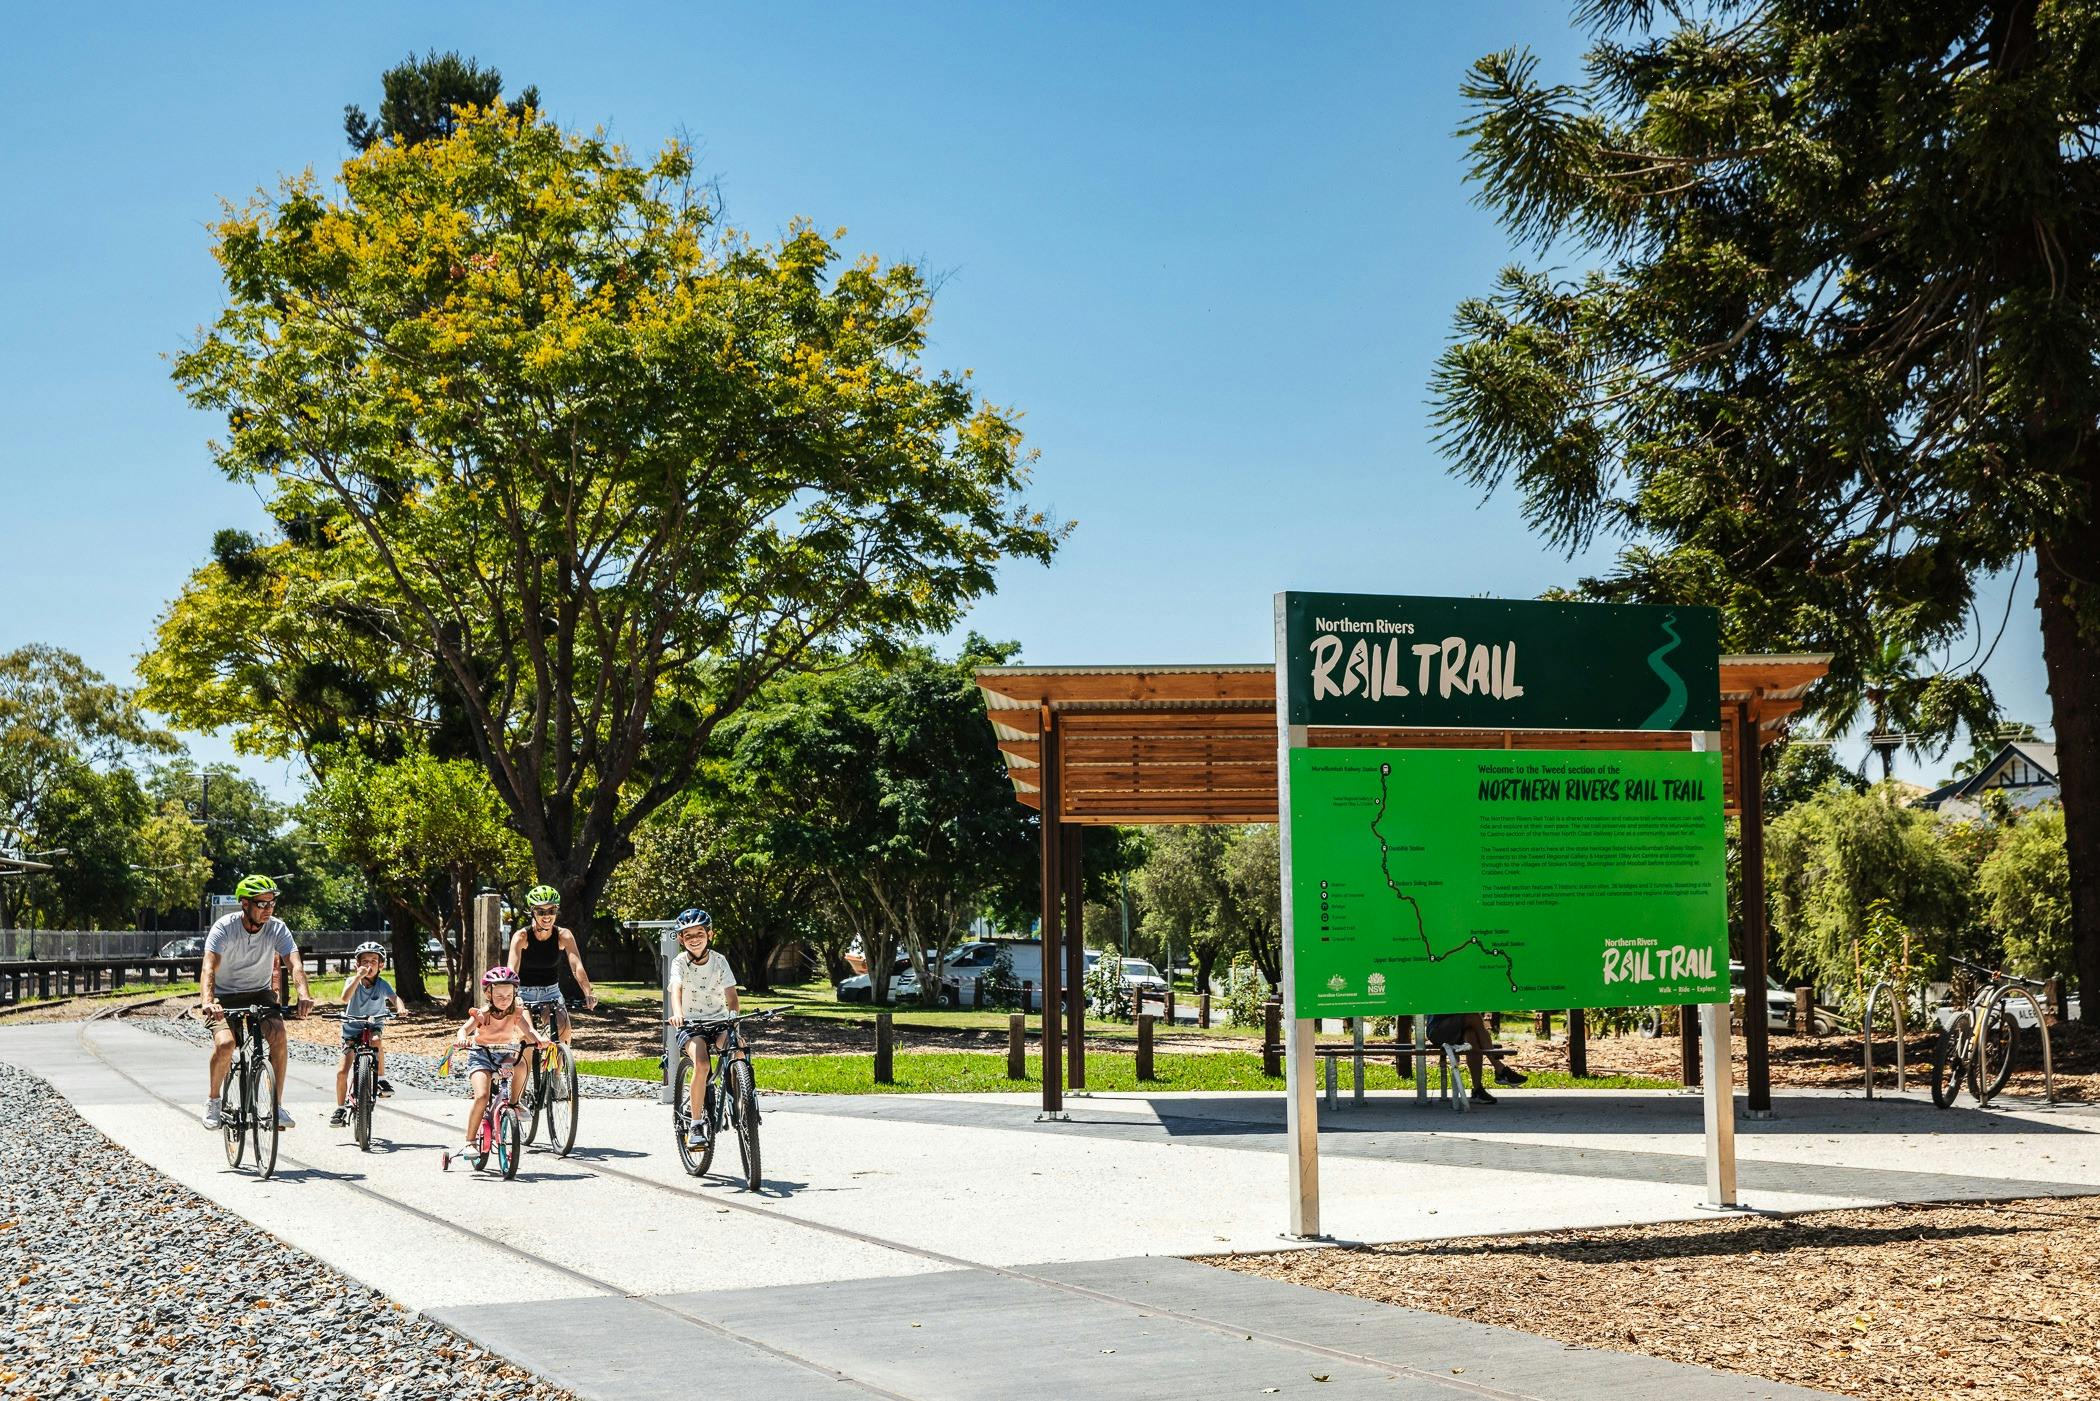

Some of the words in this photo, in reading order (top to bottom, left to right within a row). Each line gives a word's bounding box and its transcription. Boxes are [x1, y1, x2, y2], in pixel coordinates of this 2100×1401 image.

[1316, 617, 1374, 633] Northern
[1376, 619, 1415, 634] Rivers
[1309, 634, 1410, 701] RAIL
[1411, 636, 1524, 701] TRAIL
[1478, 764, 1514, 774] Welcome
[1516, 765, 1524, 774] to
[1526, 764, 1539, 774] the
[1541, 764, 1566, 774] Tweed
[1568, 764, 1596, 774] section
[1598, 764, 1606, 774] of
[1607, 764, 1620, 774] the
[1478, 779, 1560, 802] NORTHERN
[1565, 779, 1620, 802] RIVERS
[1624, 779, 1659, 802] RAIL
[1662, 779, 1706, 802] TRAIL
[1604, 938, 1636, 946] Northern
[1637, 938, 1658, 946] Rivers
[1602, 948, 1656, 984] RAIL
[1656, 945, 1717, 980] TRAIL
[1368, 985, 1386, 993] NSW
[1696, 986, 1716, 994] Explore
